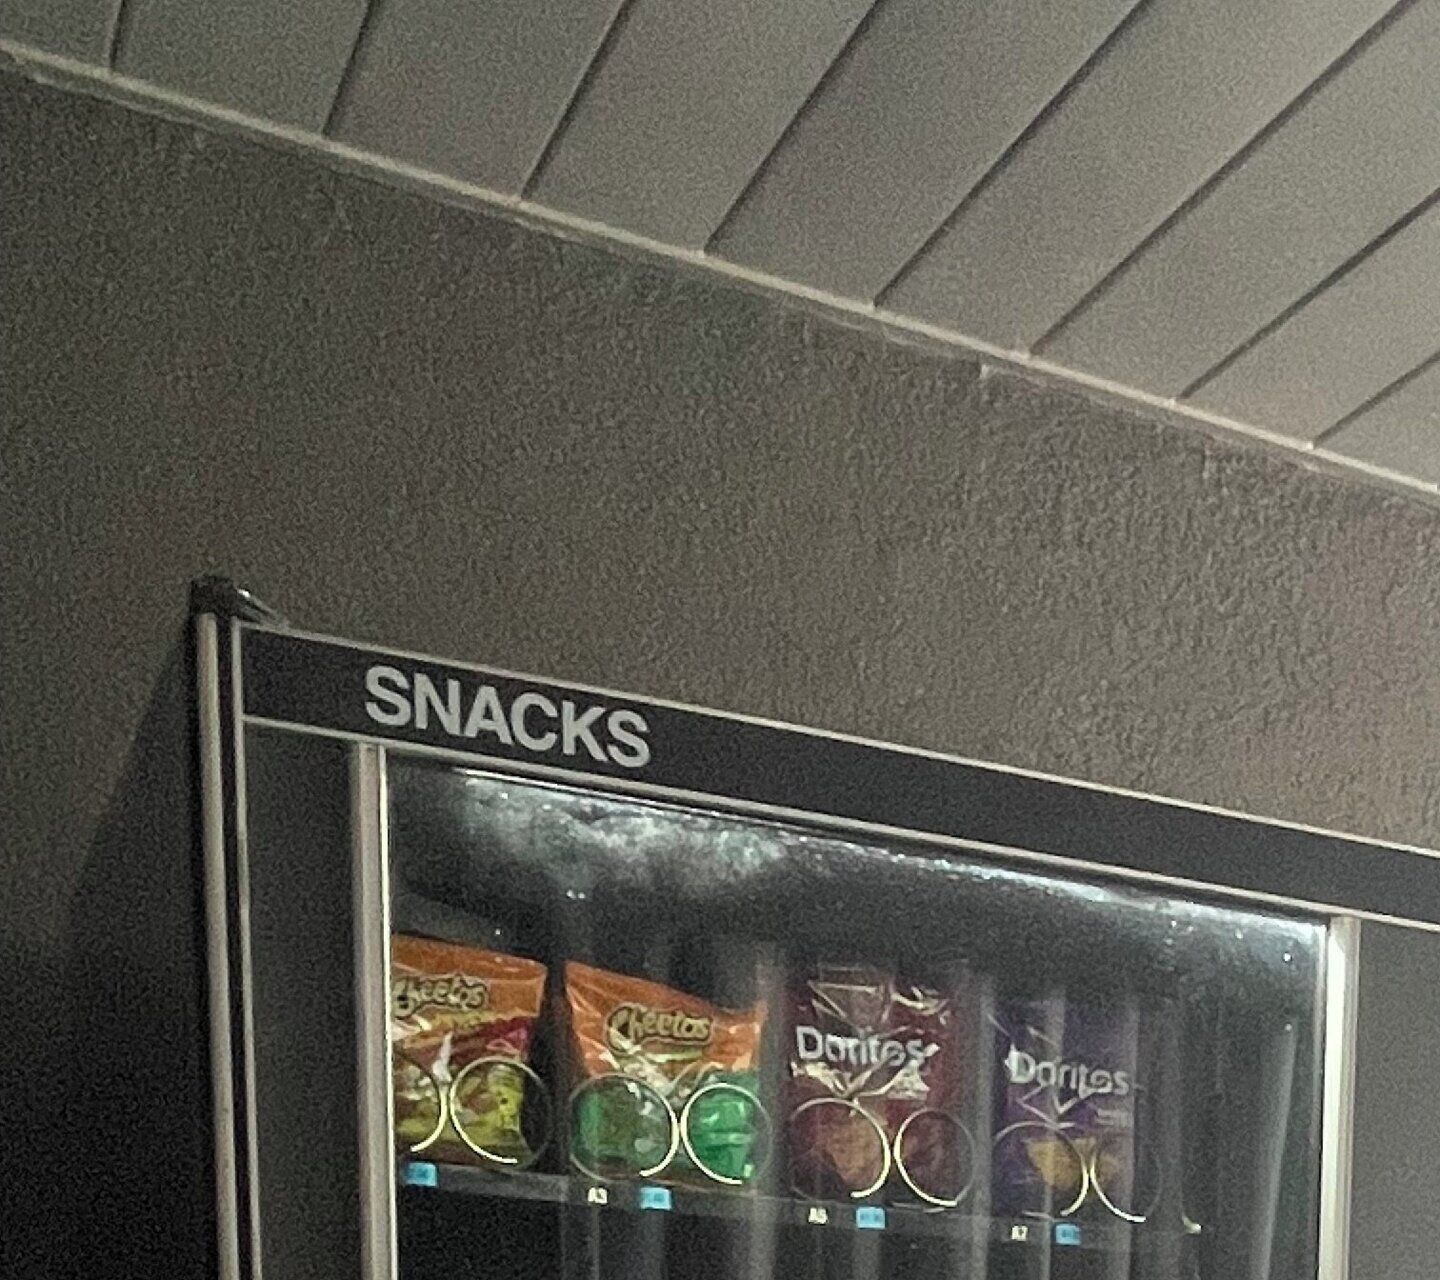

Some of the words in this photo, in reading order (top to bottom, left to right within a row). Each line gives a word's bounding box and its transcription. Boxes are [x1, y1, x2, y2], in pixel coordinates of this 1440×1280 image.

[365, 665, 652, 769] SNACKS
[606, 1003, 713, 1052] Cheetos
[796, 1024, 927, 1067] Doritos
[1008, 1048, 1131, 1096] Doritos
